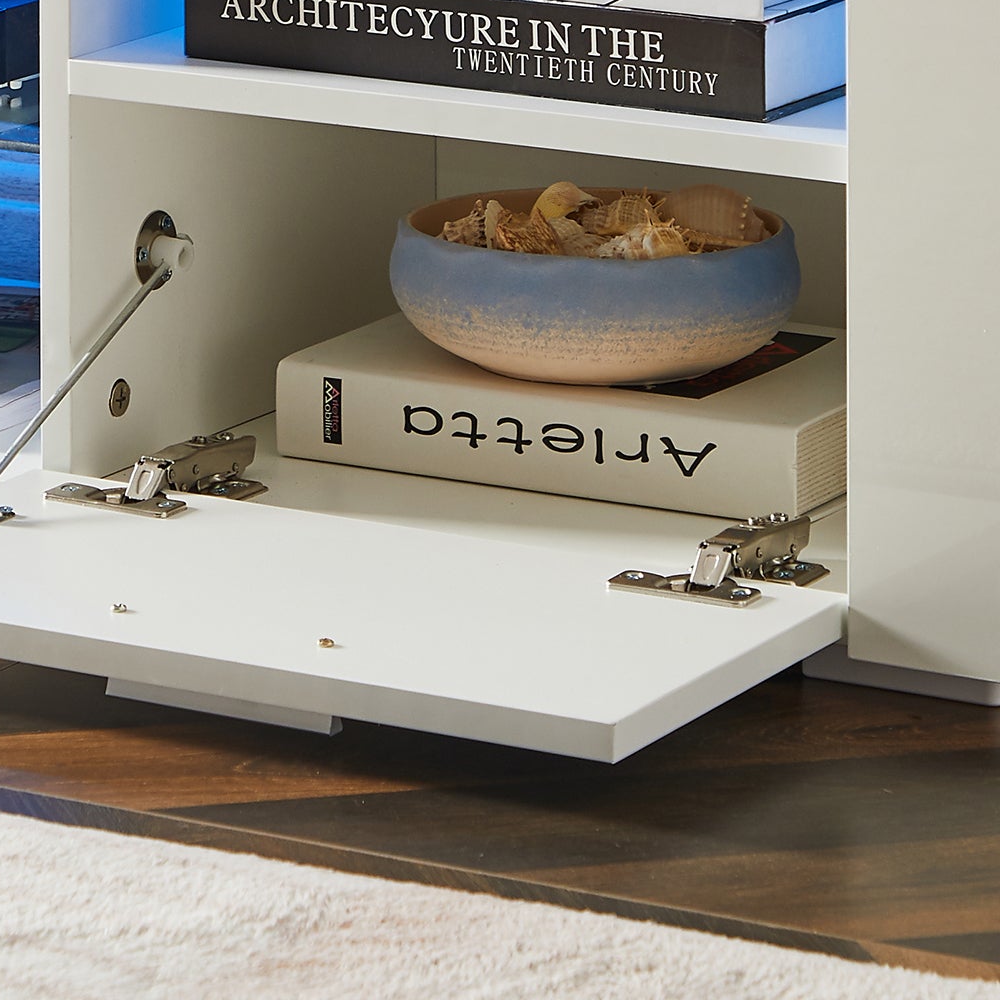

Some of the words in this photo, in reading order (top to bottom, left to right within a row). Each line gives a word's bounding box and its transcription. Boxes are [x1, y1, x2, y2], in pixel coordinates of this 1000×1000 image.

[528, 19, 571, 54] IN
[581, 25, 665, 64] THE
[453, 47, 594, 83] TWENTIETH
[607, 63, 719, 96] CENTURY
[325, 380, 333, 441] Mobilier
[403, 405, 717, 477] Arletta
